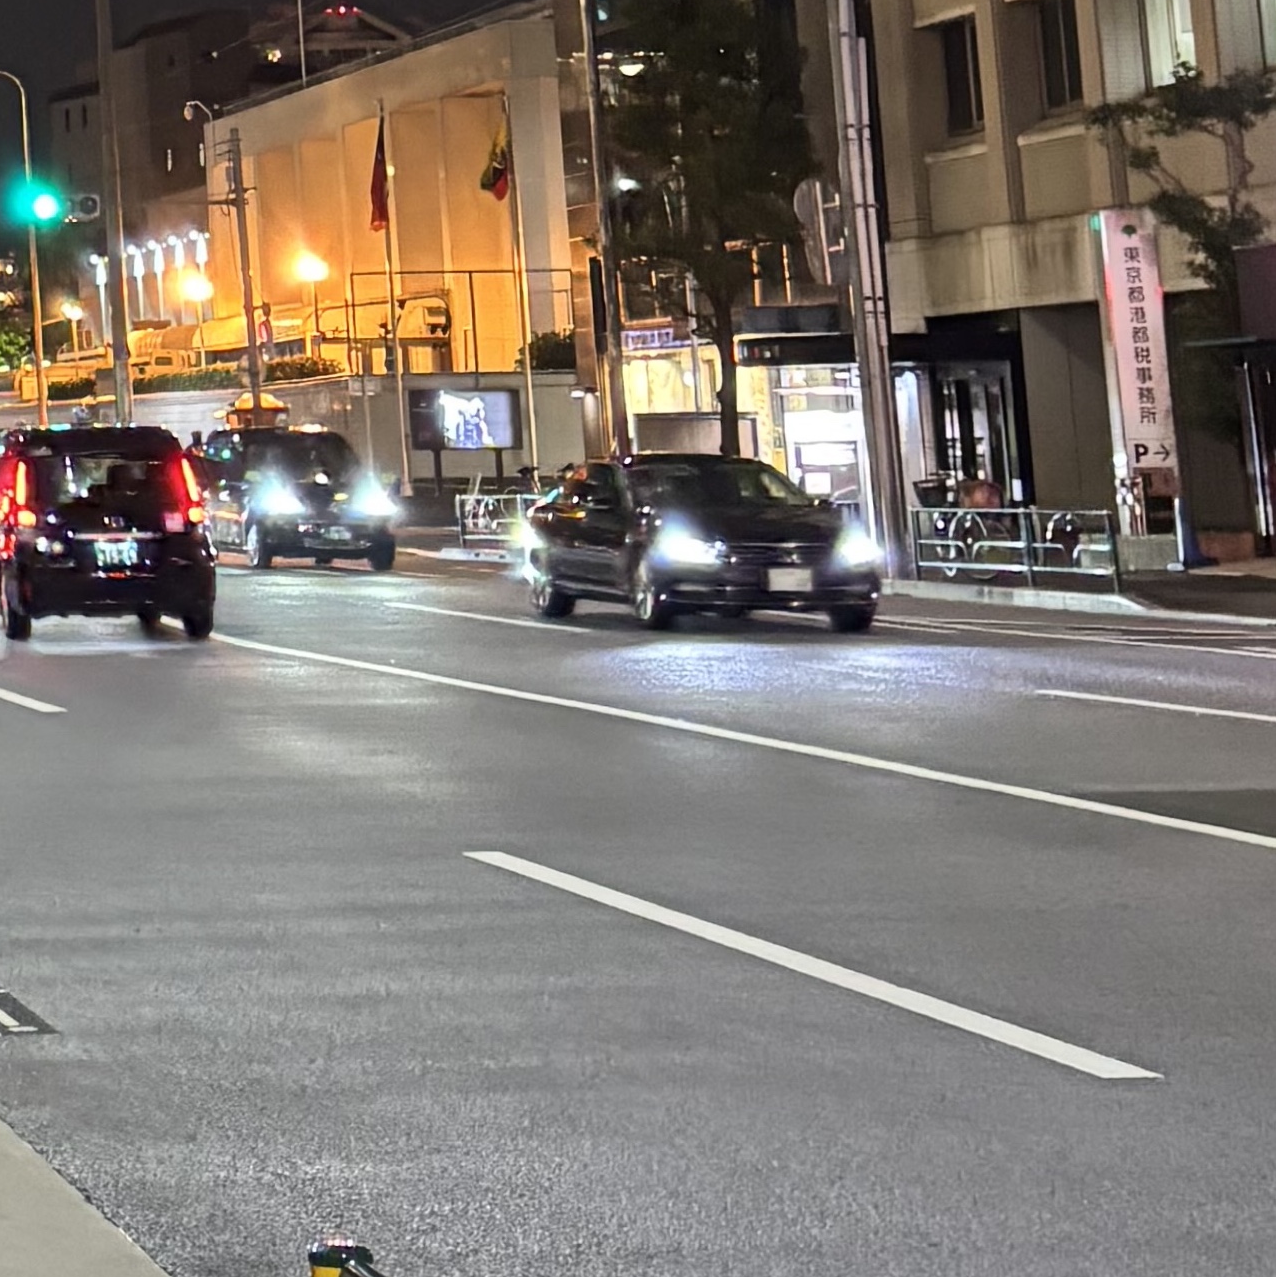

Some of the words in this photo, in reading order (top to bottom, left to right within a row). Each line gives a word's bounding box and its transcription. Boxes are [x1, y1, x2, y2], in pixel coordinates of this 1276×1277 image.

[1123, 246, 1158, 425] 東京都港都税事務所
[1134, 443, 1149, 464] P
